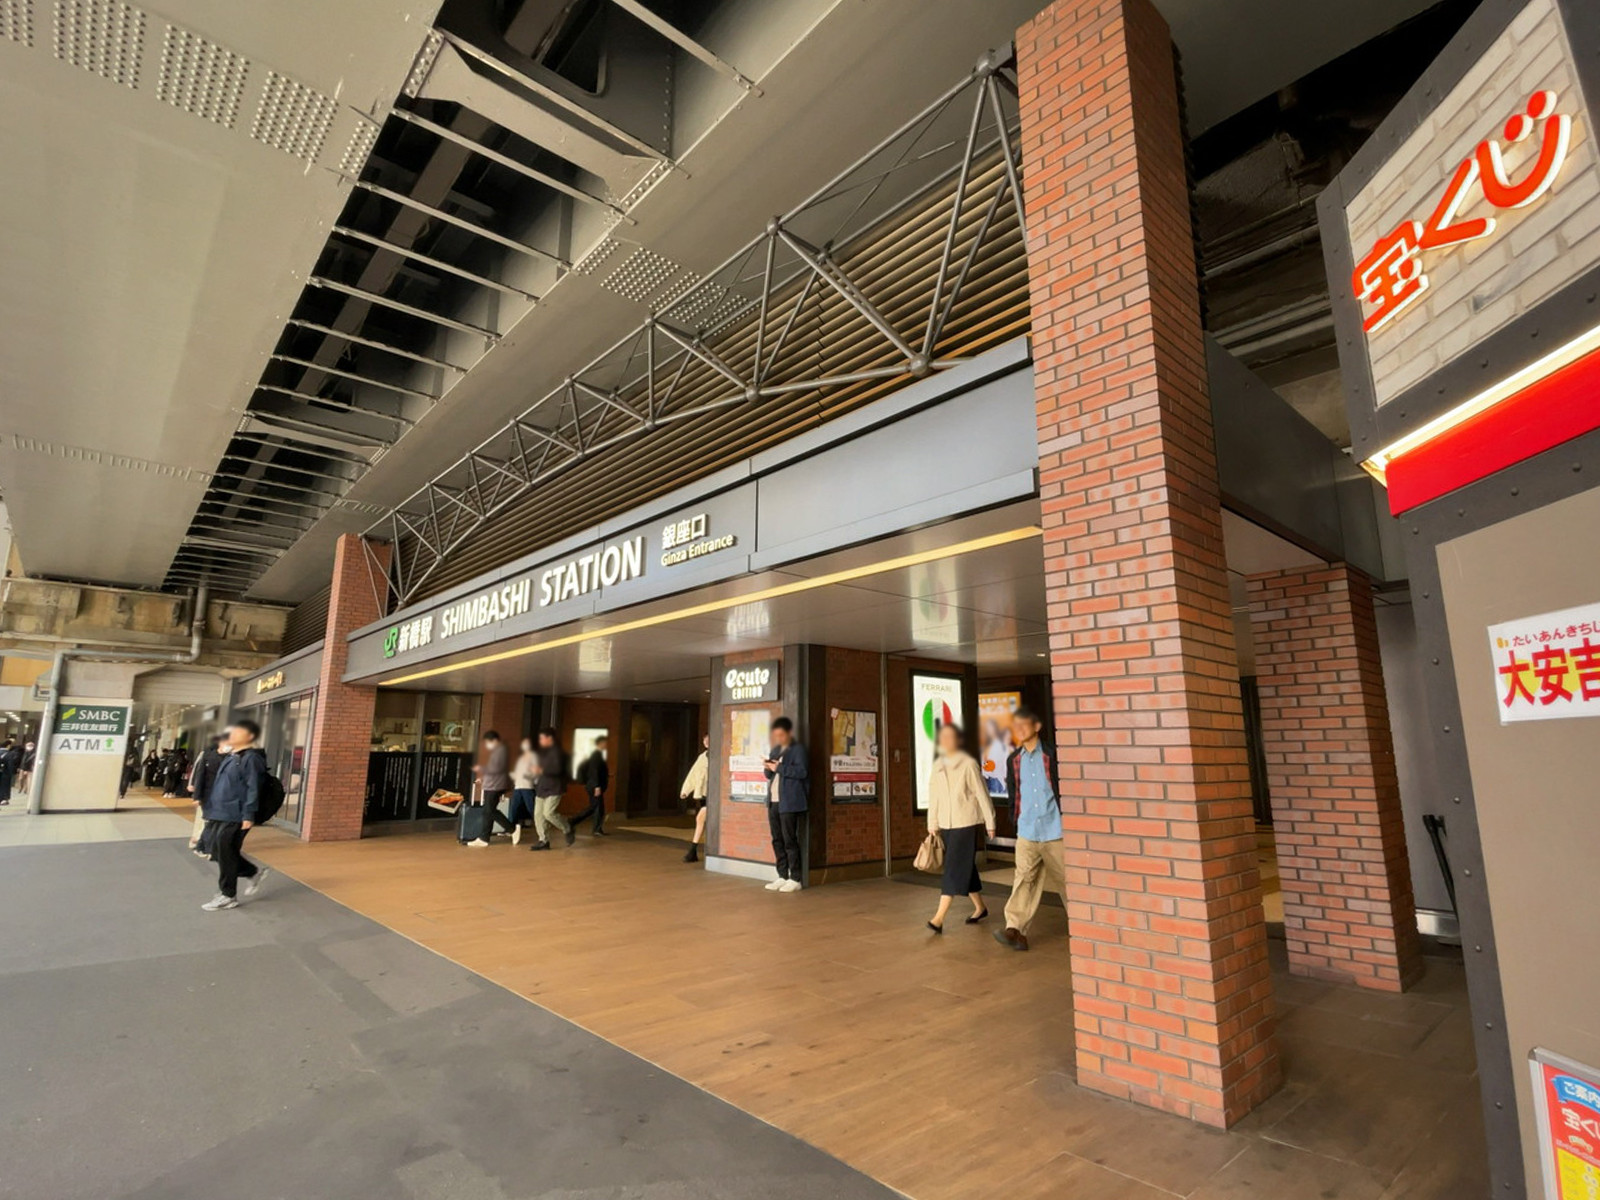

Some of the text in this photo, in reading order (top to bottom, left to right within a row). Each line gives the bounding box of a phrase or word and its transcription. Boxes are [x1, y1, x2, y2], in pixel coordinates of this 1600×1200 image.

[1352, 90, 1571, 332] 宝くじ
[662, 514, 707, 550] 銀座口
[661, 534, 735, 567] Ginza Entrance
[441, 536, 643, 639] SHIMBASHI STATION
[398, 615, 433, 653] 新橋駅
[725, 667, 770, 689] ecute
[1498, 637, 1600, 708] 大安吉
[732, 686, 763, 700] EDITION
[78, 709, 120, 721] SMBC
[59, 738, 101, 751] ATM
